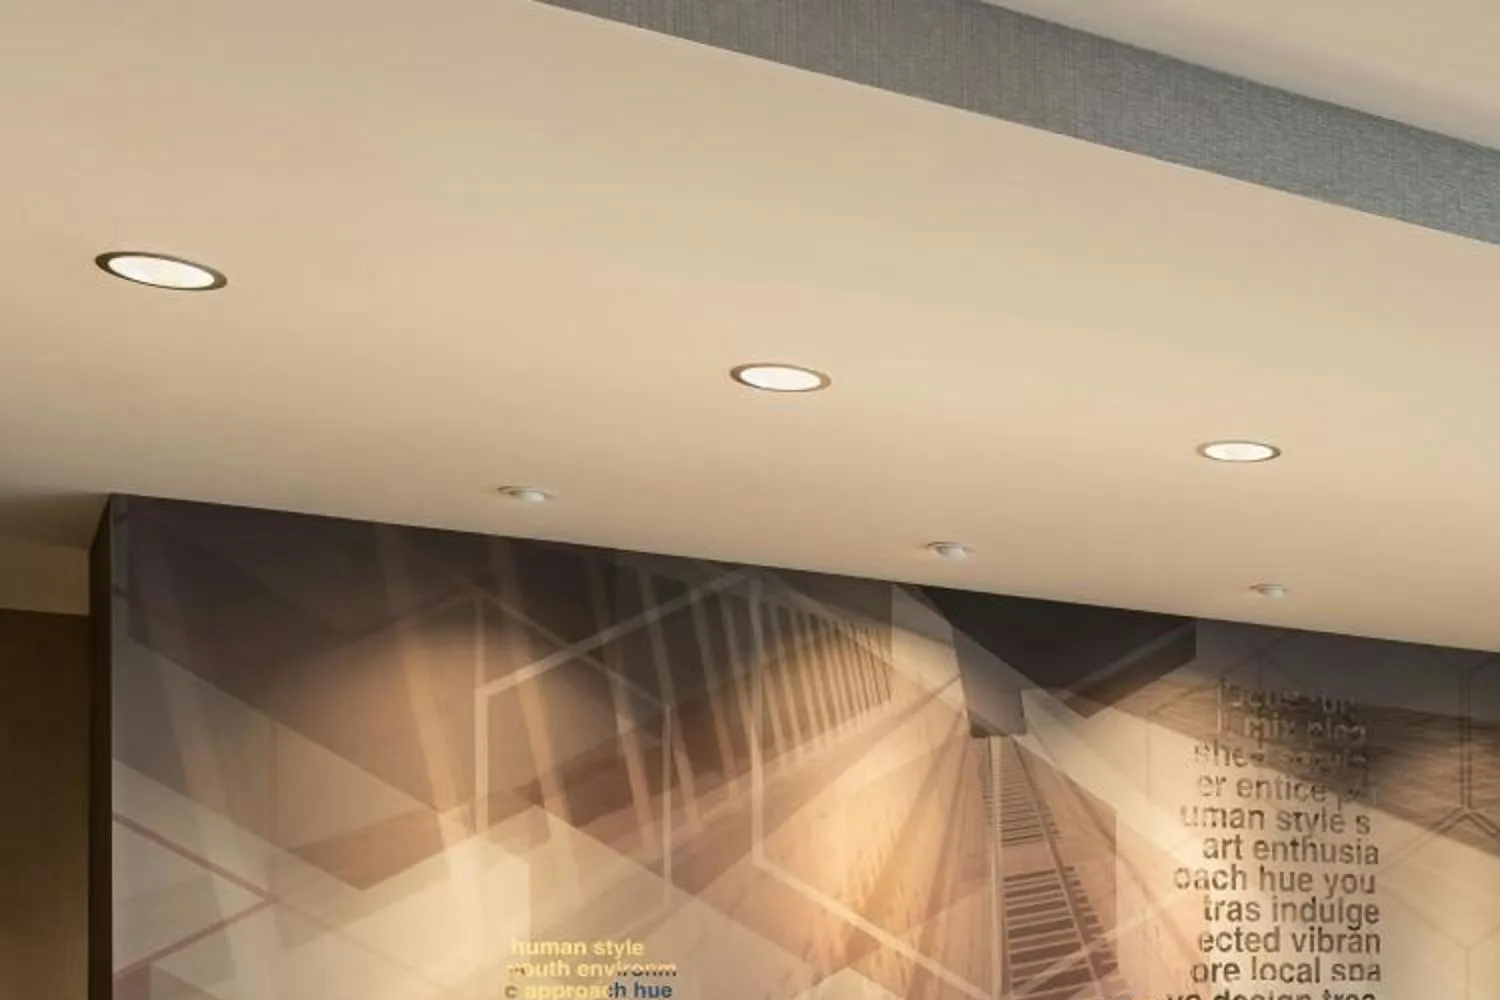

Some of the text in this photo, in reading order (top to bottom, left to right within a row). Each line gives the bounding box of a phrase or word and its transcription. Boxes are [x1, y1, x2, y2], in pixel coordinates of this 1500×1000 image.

[1236, 775, 1327, 803] entice
[1180, 805, 1371, 838] uman style s
[1203, 834, 1379, 866] art enthusia
[1174, 863, 1376, 899] oach hue you
[1271, 896, 1380, 931] indulge
[511, 937, 646, 961] human style
[1198, 926, 1381, 954] ected vibran
[1190, 961, 1241, 984] ore
[1250, 956, 1321, 983] local
[632, 980, 673, 999] hue
